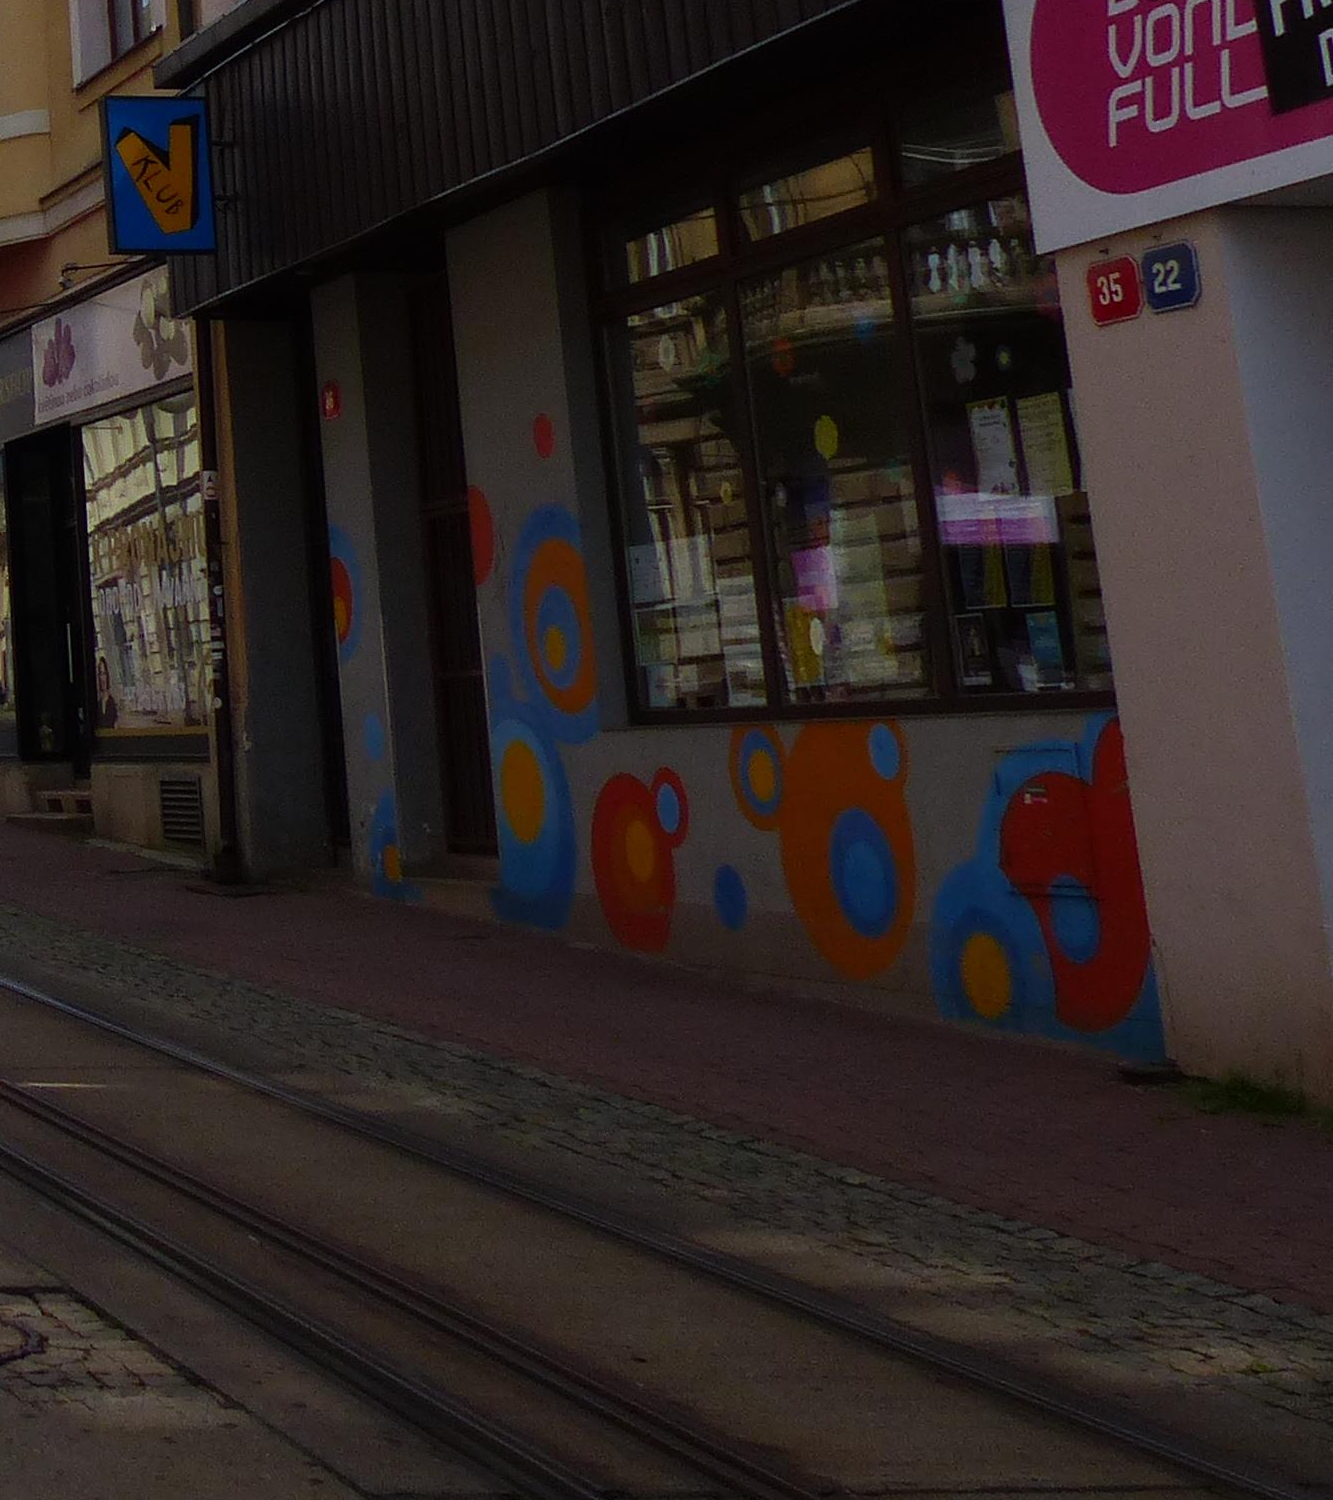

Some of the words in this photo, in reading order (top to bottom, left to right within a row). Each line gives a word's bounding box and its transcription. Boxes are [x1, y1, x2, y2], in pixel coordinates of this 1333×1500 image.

[1108, 48, 1269, 148] FULL
[131, 154, 184, 215] KLUB
[1096, 271, 1123, 306] 35
[1152, 259, 1182, 294] 22
